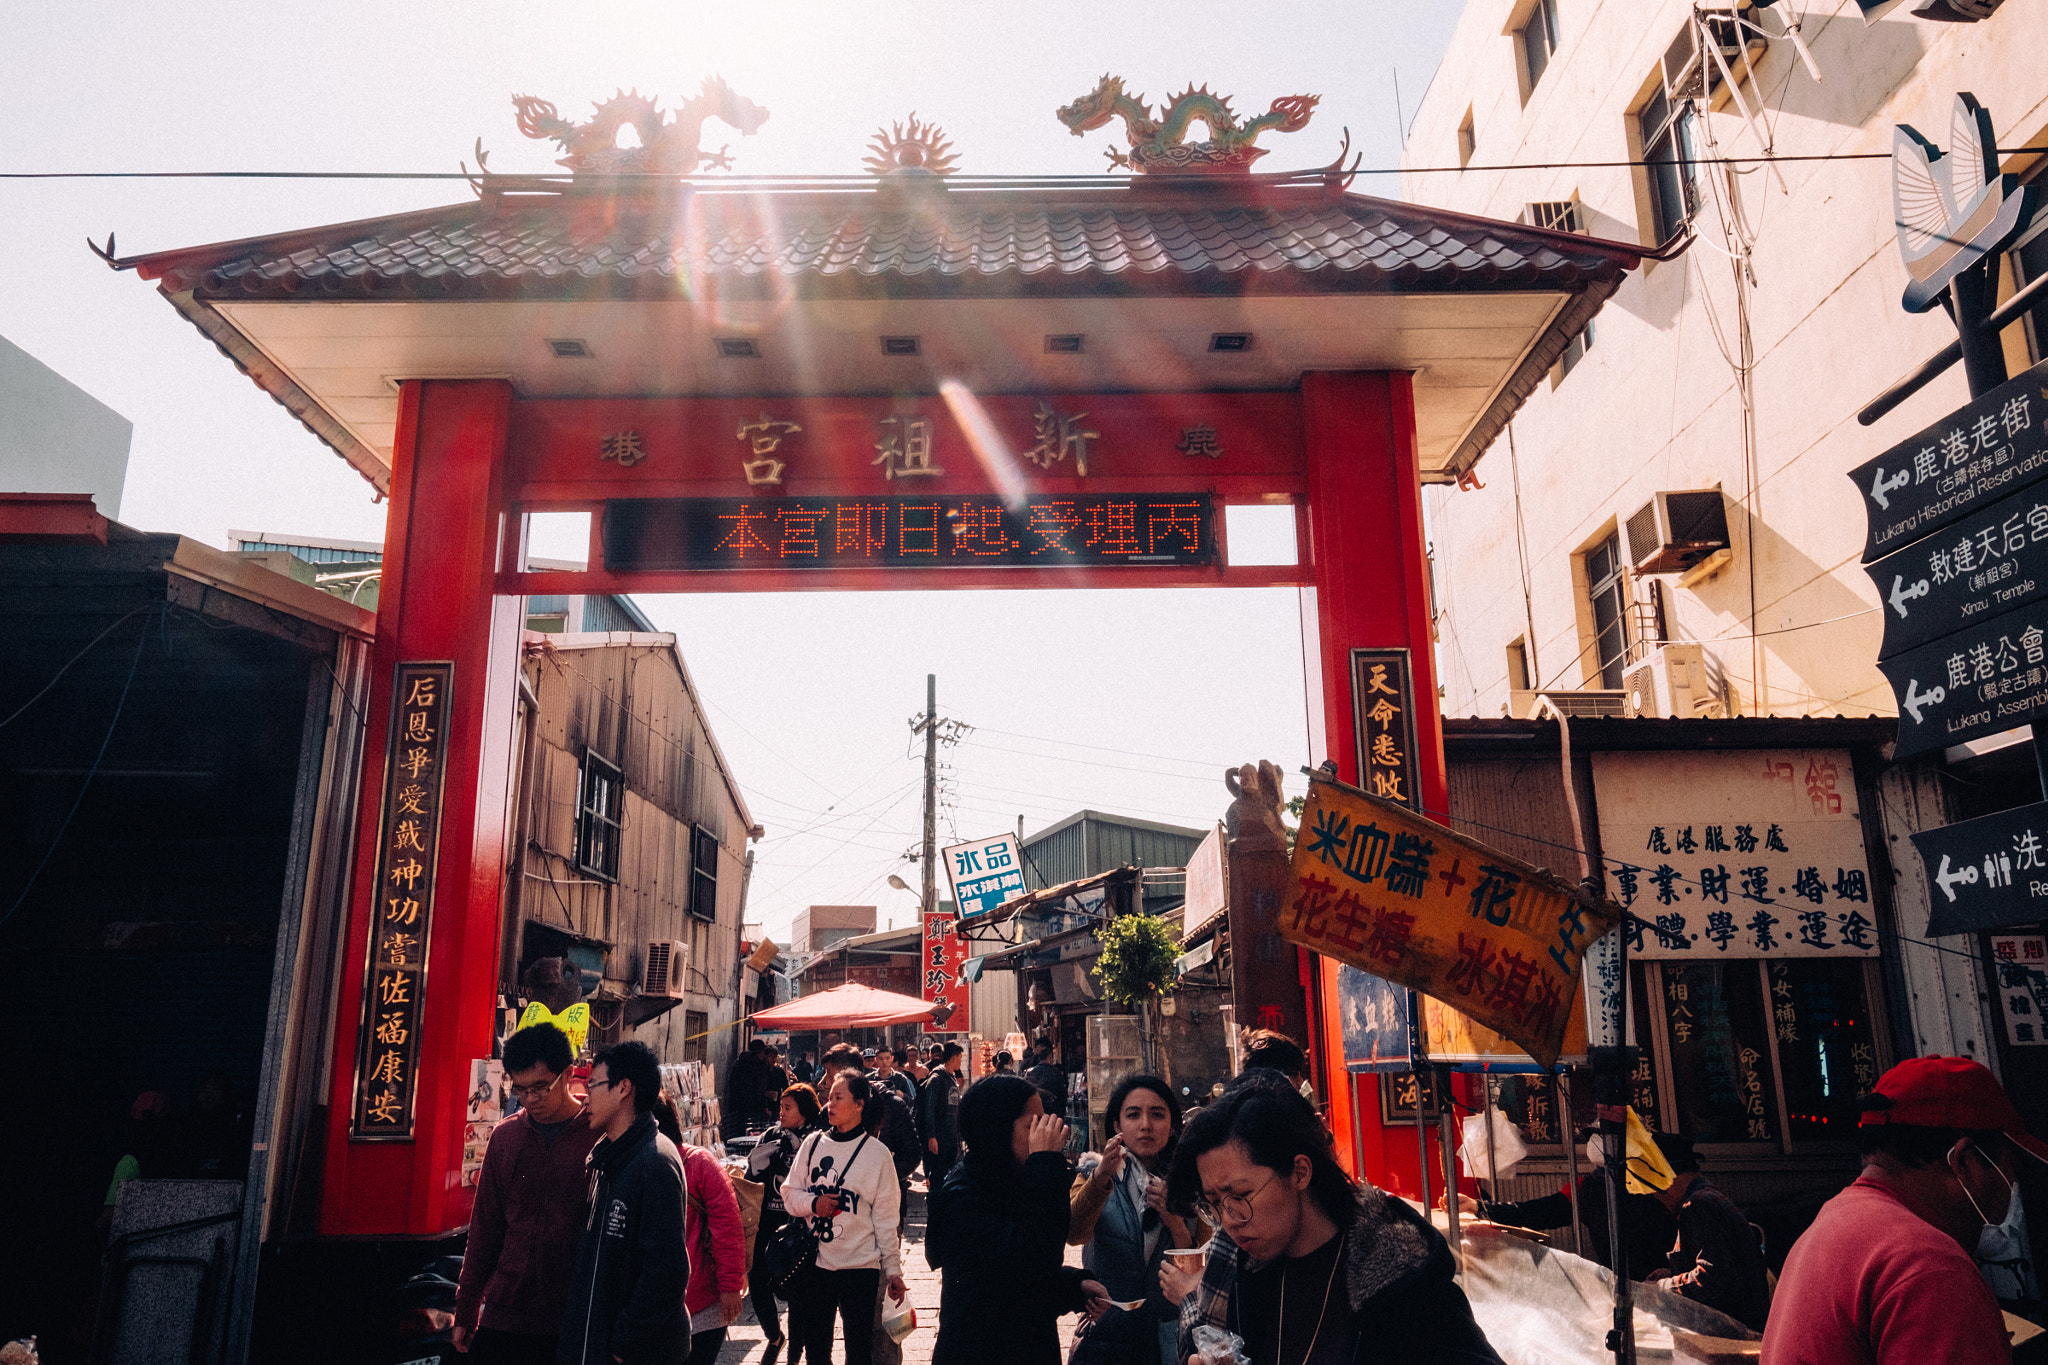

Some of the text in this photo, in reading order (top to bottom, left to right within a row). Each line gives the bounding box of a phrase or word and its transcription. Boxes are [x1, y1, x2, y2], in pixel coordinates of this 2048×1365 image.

[1913, 393, 2031, 485] 鹿港老街
[713, 499, 1202, 559] 本宮即日起受理丙
[1875, 514, 1917, 546] Lukang
[1917, 481, 1976, 530] Historical
[1960, 578, 2036, 618] Xinzu Temple
[1968, 557, 2019, 593] (新祖宮)
[1946, 624, 2045, 691] 鹿港公會
[1947, 708, 1991, 735] Lukang
[1646, 823, 1790, 855] 鹿港服務處
[2012, 829, 2048, 872] 洗
[1291, 872, 1416, 967] 花生糖
